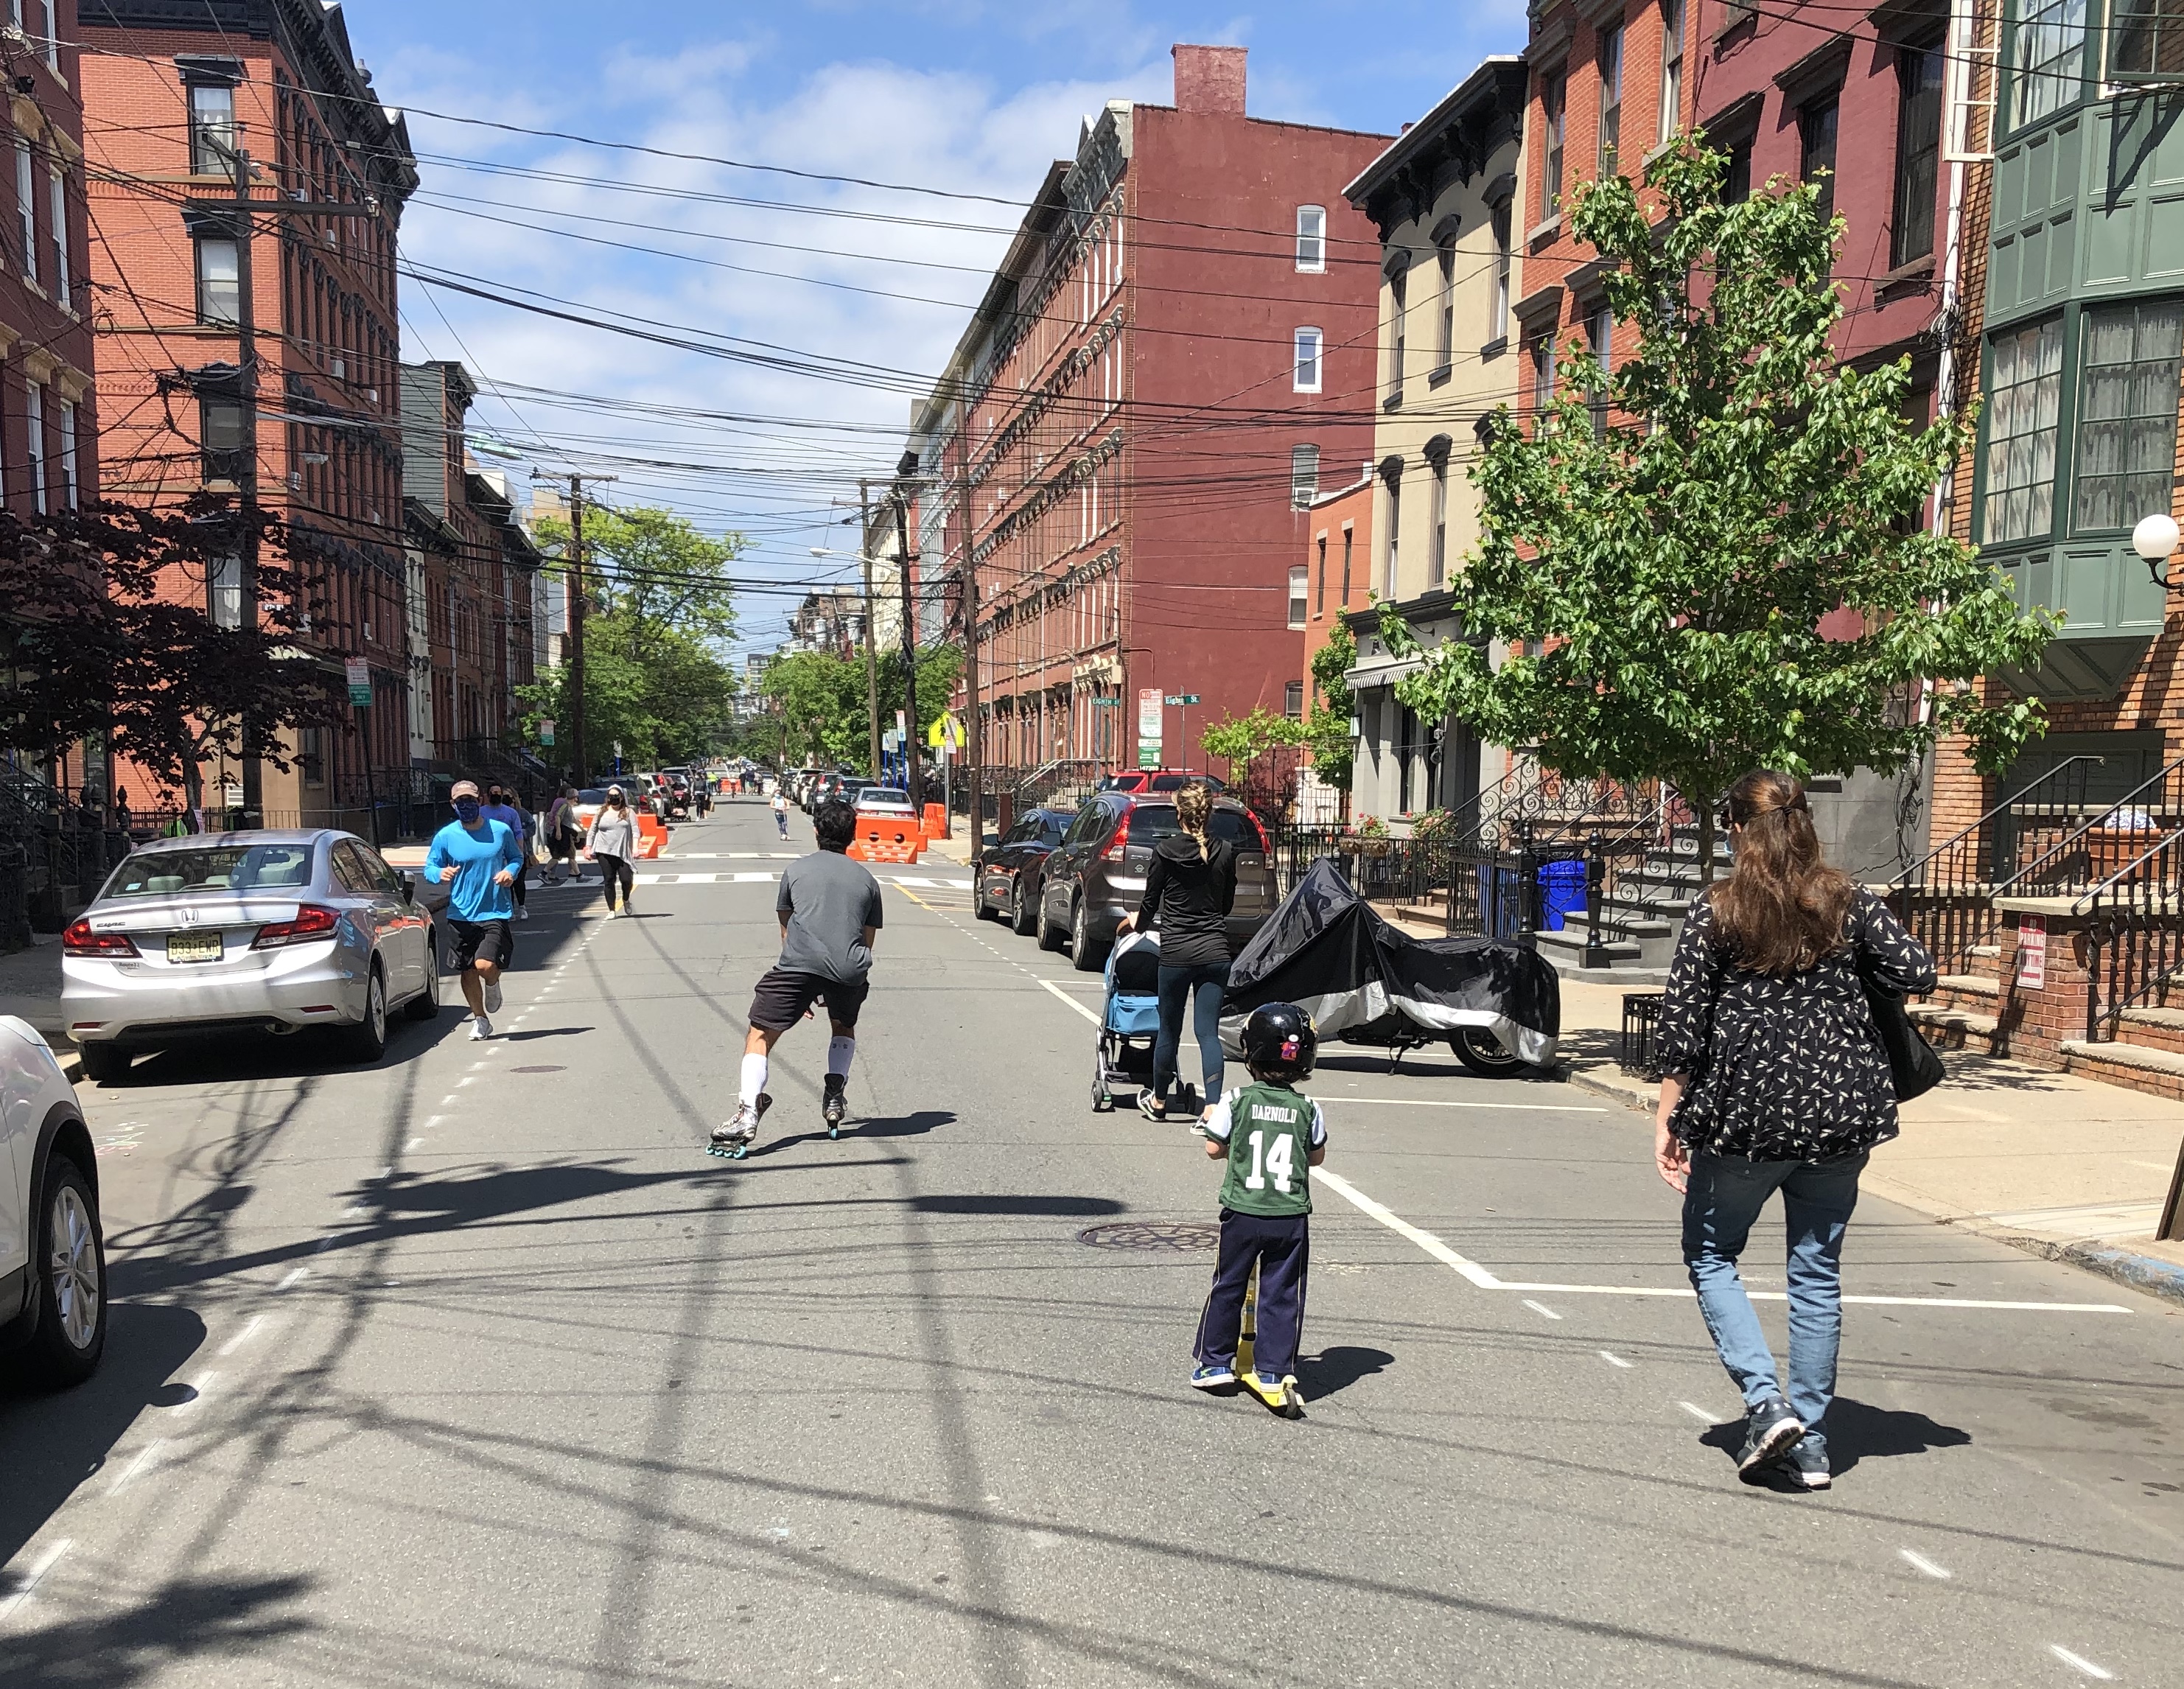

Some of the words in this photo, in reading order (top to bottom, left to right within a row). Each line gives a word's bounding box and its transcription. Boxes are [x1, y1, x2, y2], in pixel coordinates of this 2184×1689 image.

[2028, 918, 2037, 932] NO
[2019, 932, 2045, 948] PARKING
[1251, 1104, 1298, 1124] DARNOLD
[1245, 1130, 1294, 1192] 14
